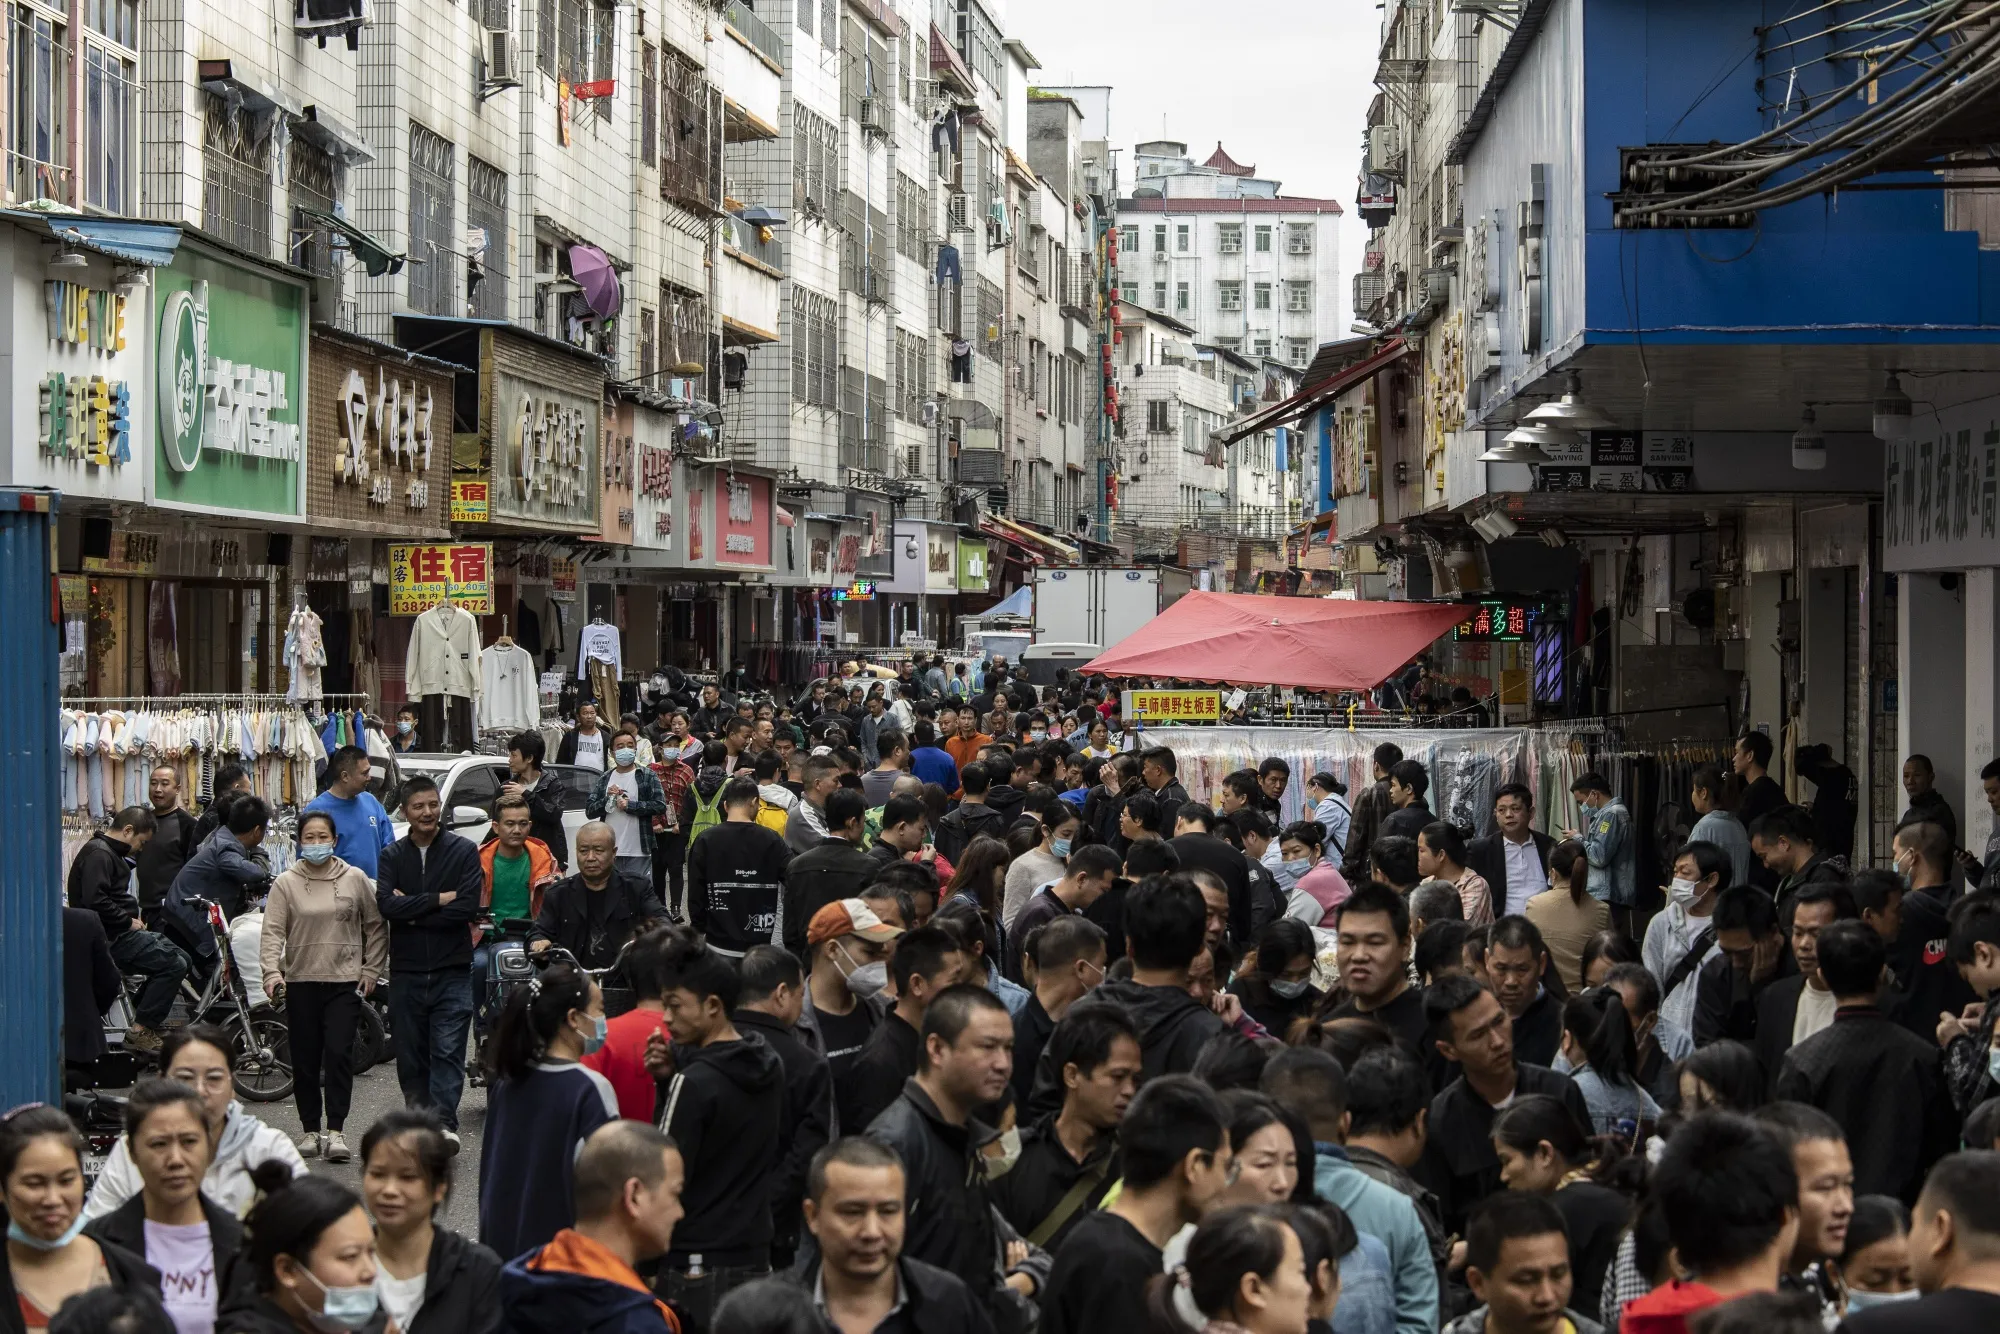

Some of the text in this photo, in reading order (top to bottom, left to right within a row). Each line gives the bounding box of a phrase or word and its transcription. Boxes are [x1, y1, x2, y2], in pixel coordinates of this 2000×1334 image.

[50, 280, 127, 352] YUE YUE
[1598, 437, 1636, 454] 三盈
[1649, 437, 1687, 454] 三盈
[1550, 454, 1583, 462] ANYING
[1598, 454, 1635, 462] SANYING
[1650, 454, 1686, 462] SANYING
[1547, 471, 1584, 488] 三盈
[1598, 472, 1635, 488] 三盈
[393, 548, 408, 583] 旺客
[409, 545, 486, 584] 住宿
[394, 592, 438, 600] 直入巷内
[1138, 696, 1216, 715] 吴师傅野生板栗
